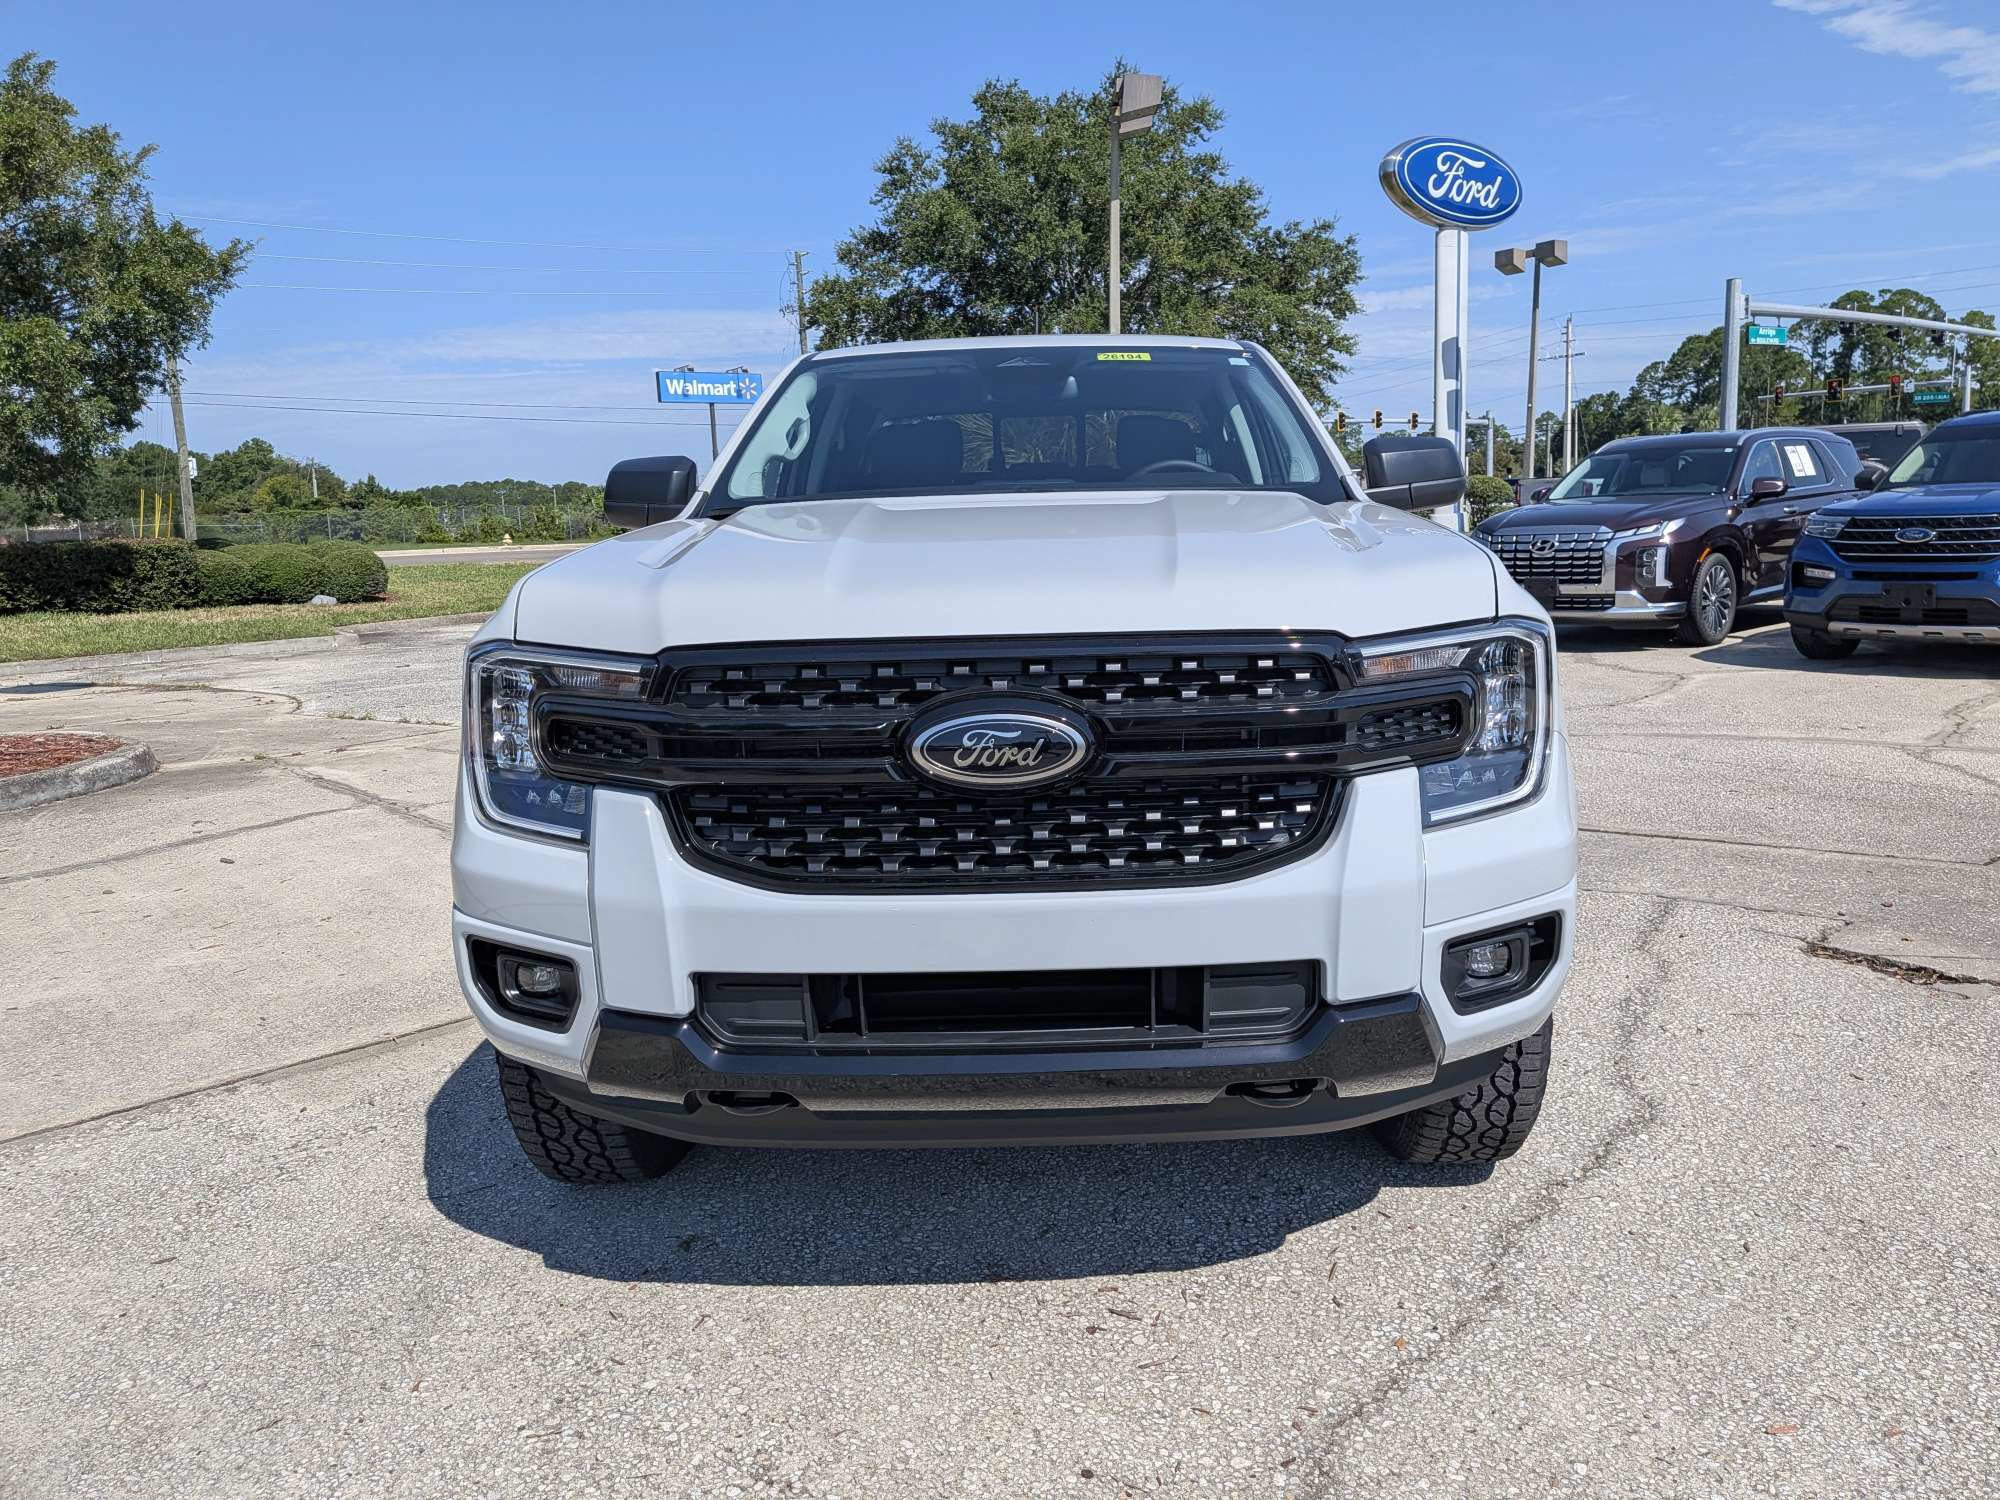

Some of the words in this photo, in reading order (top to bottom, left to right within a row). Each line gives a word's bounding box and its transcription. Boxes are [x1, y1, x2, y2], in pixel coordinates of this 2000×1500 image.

[1427, 151, 1503, 208] Ford
[665, 378, 737, 396] Walmart
[953, 729, 1045, 767] Ford
